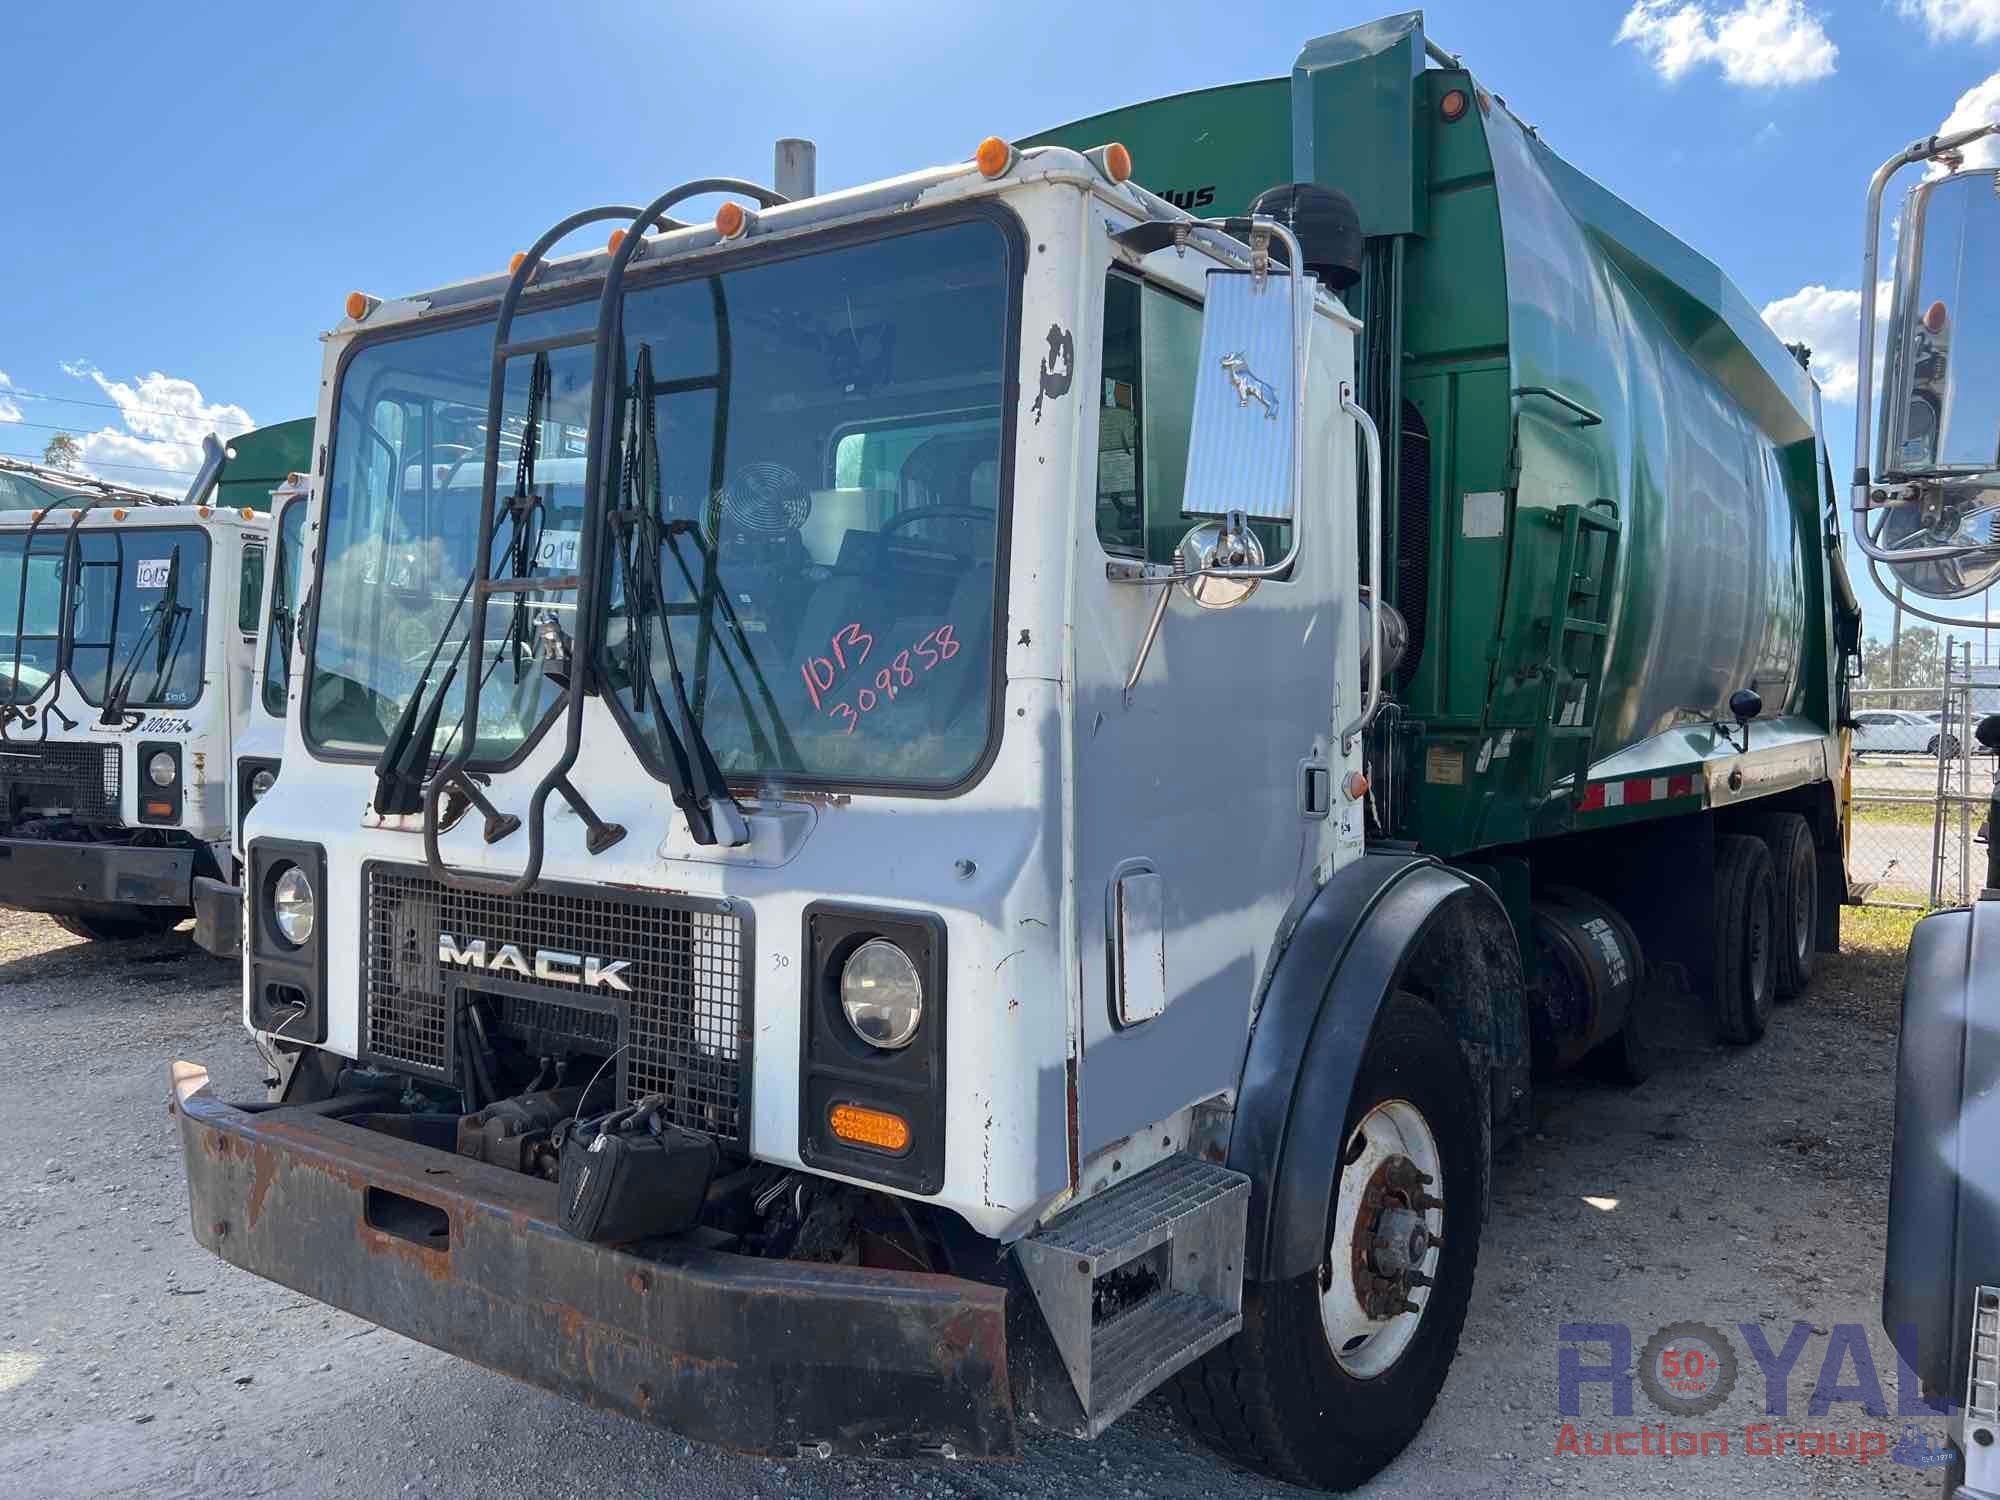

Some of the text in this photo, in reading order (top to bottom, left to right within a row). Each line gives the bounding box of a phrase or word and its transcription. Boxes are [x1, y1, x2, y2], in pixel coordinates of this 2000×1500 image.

[801, 623, 873, 711] 1013
[829, 623, 961, 736] 309858
[438, 934, 633, 992] MACK
